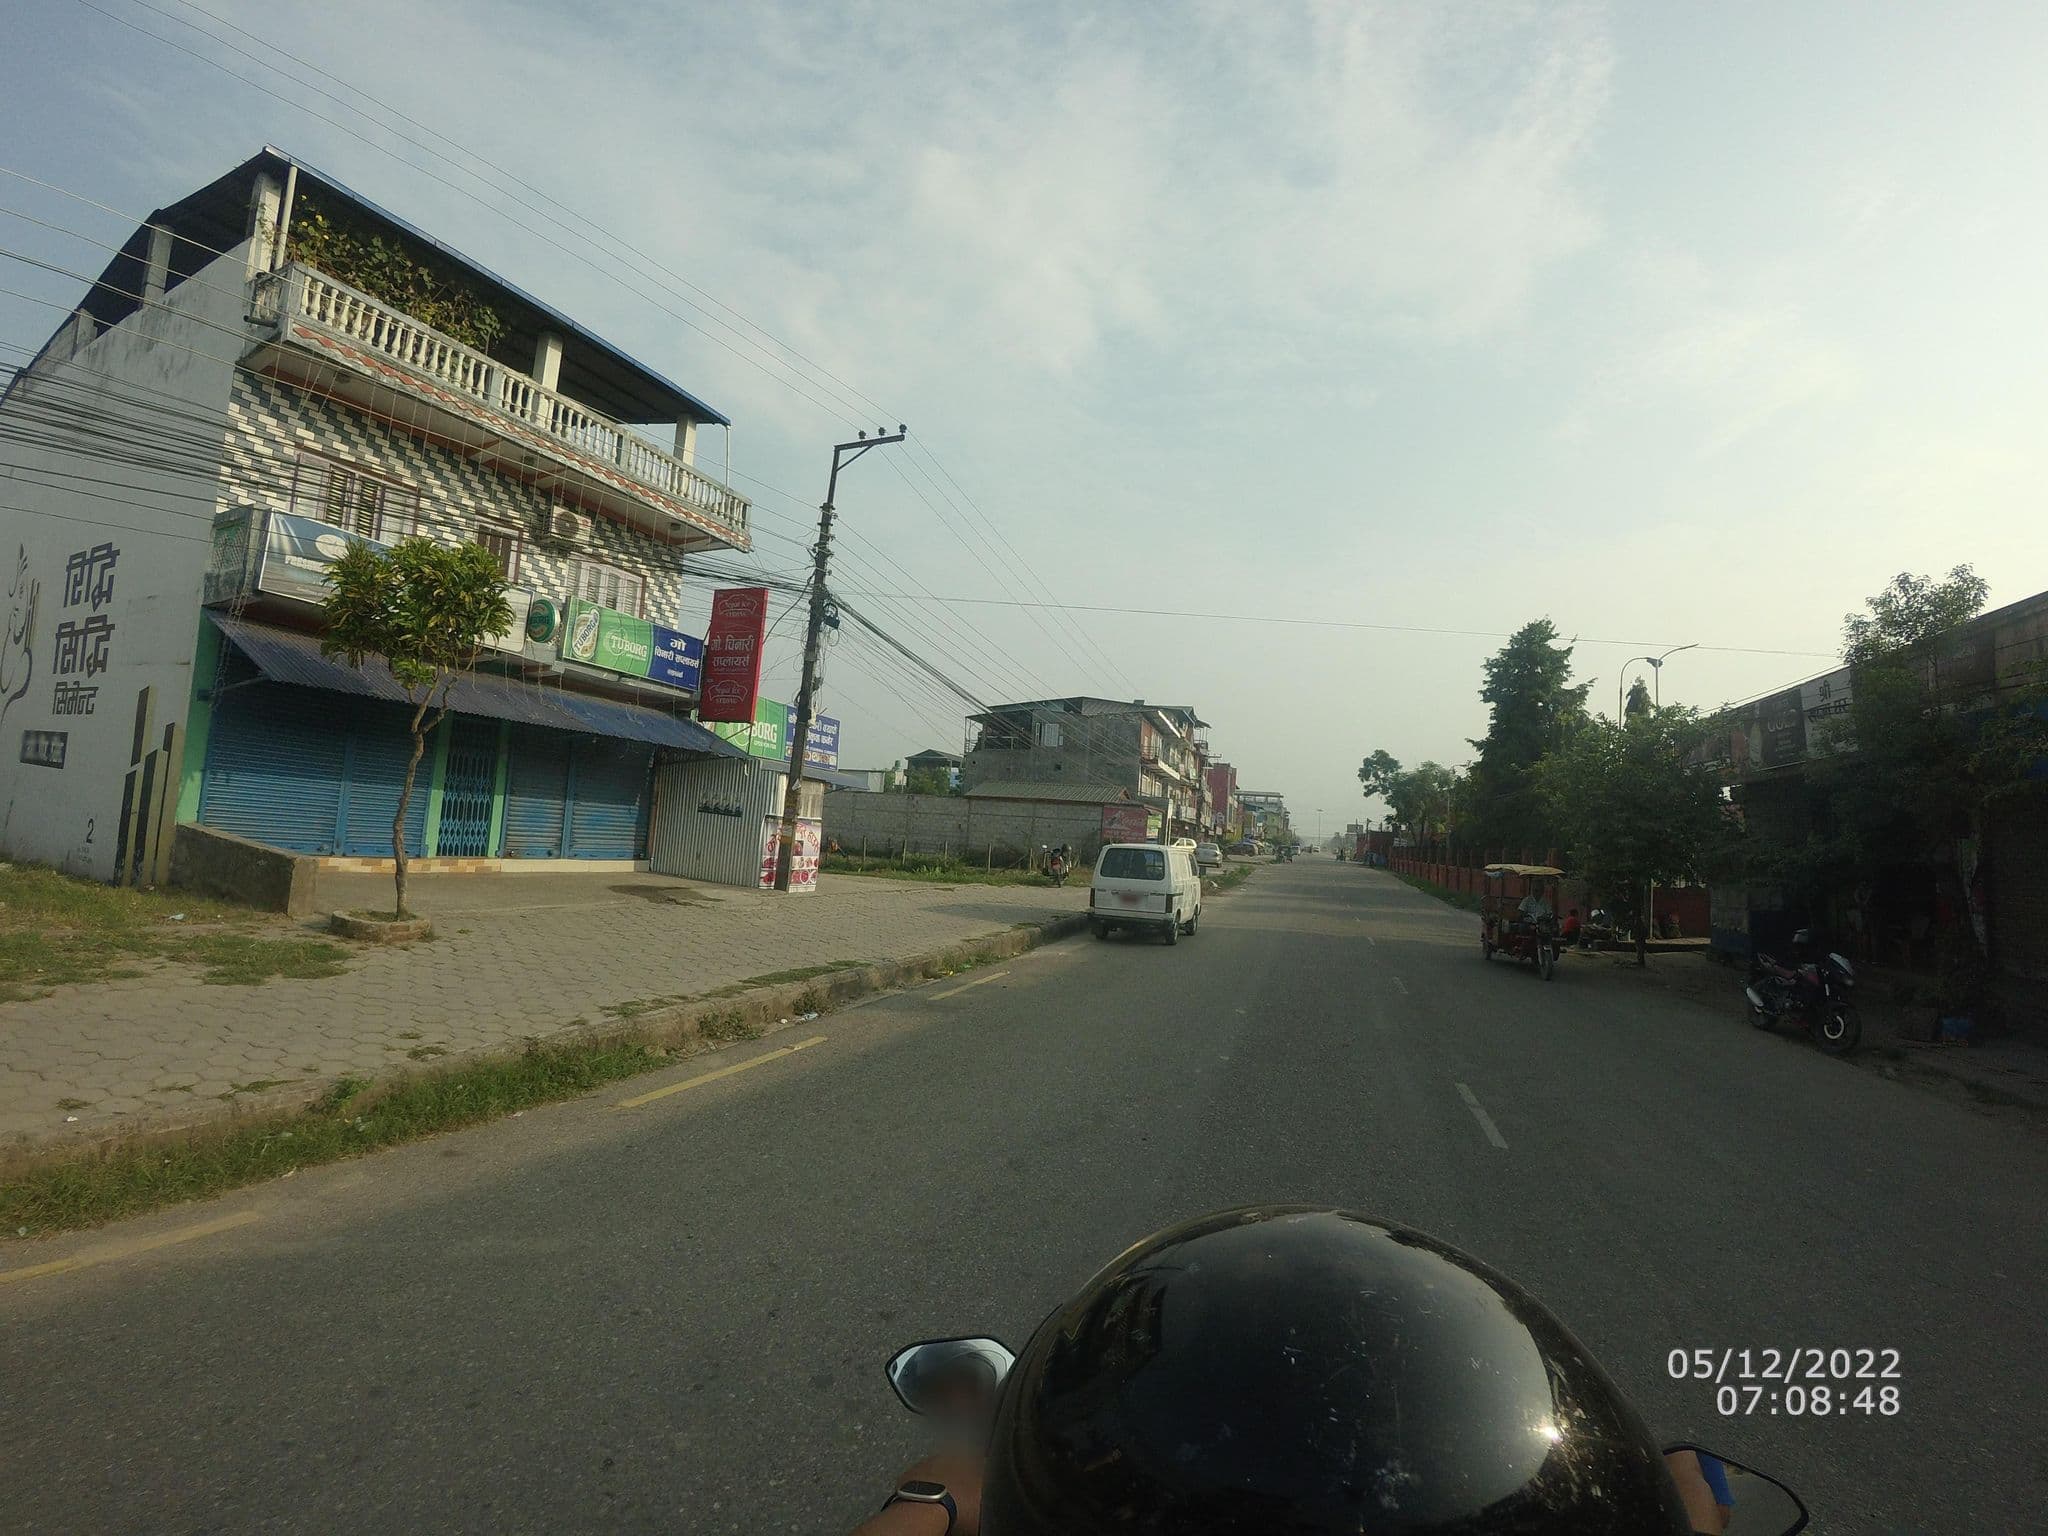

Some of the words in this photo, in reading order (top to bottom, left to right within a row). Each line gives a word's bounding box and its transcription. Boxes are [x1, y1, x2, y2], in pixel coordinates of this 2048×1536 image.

[64, 541, 120, 612] रिद्धि
[52, 614, 116, 679] सिद्धि
[574, 612, 599, 651] TUBORG
[610, 635, 648, 658] TUBORG
[52, 681, 99, 716] सिमेन्ट
